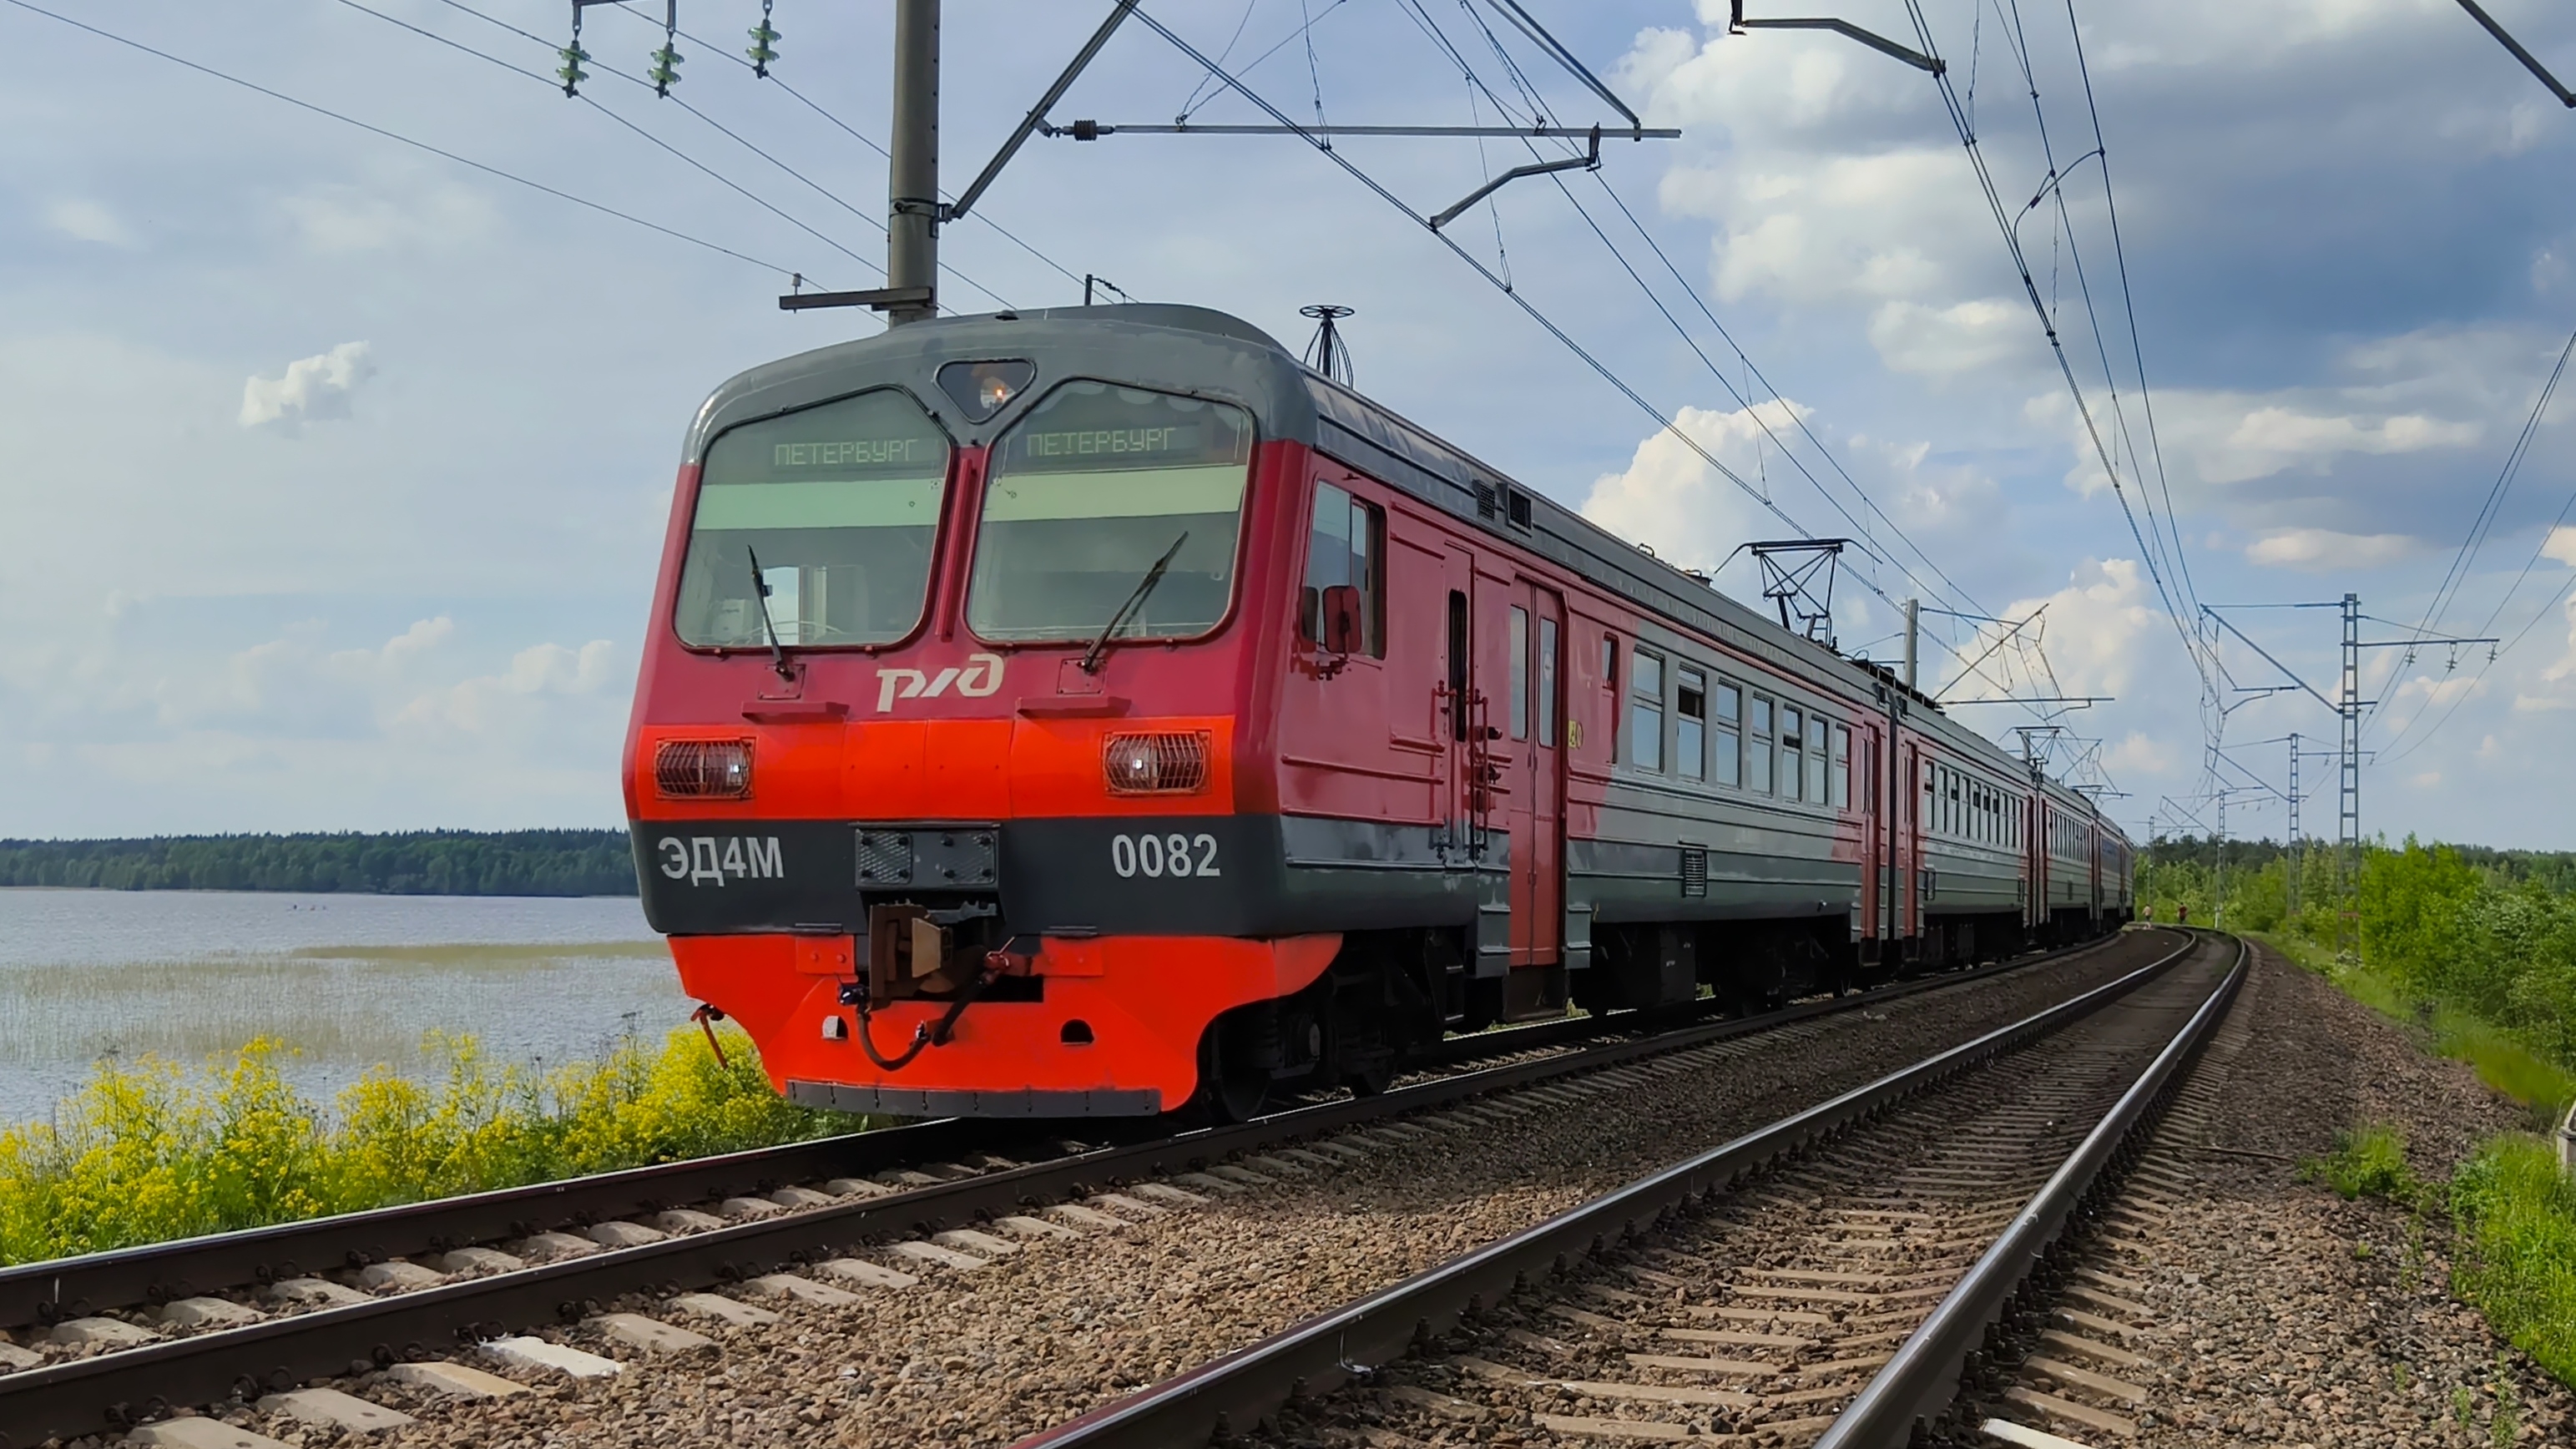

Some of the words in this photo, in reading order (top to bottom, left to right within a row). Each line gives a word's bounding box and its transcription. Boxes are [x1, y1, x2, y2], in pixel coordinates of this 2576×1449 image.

[775, 439, 918, 466] ПЕТЕРБУРГ
[1027, 427, 1176, 457] ПЕТЕРБУРГ
[659, 836, 784, 886] ЭД4М
[1113, 834, 1220, 877] 0082
